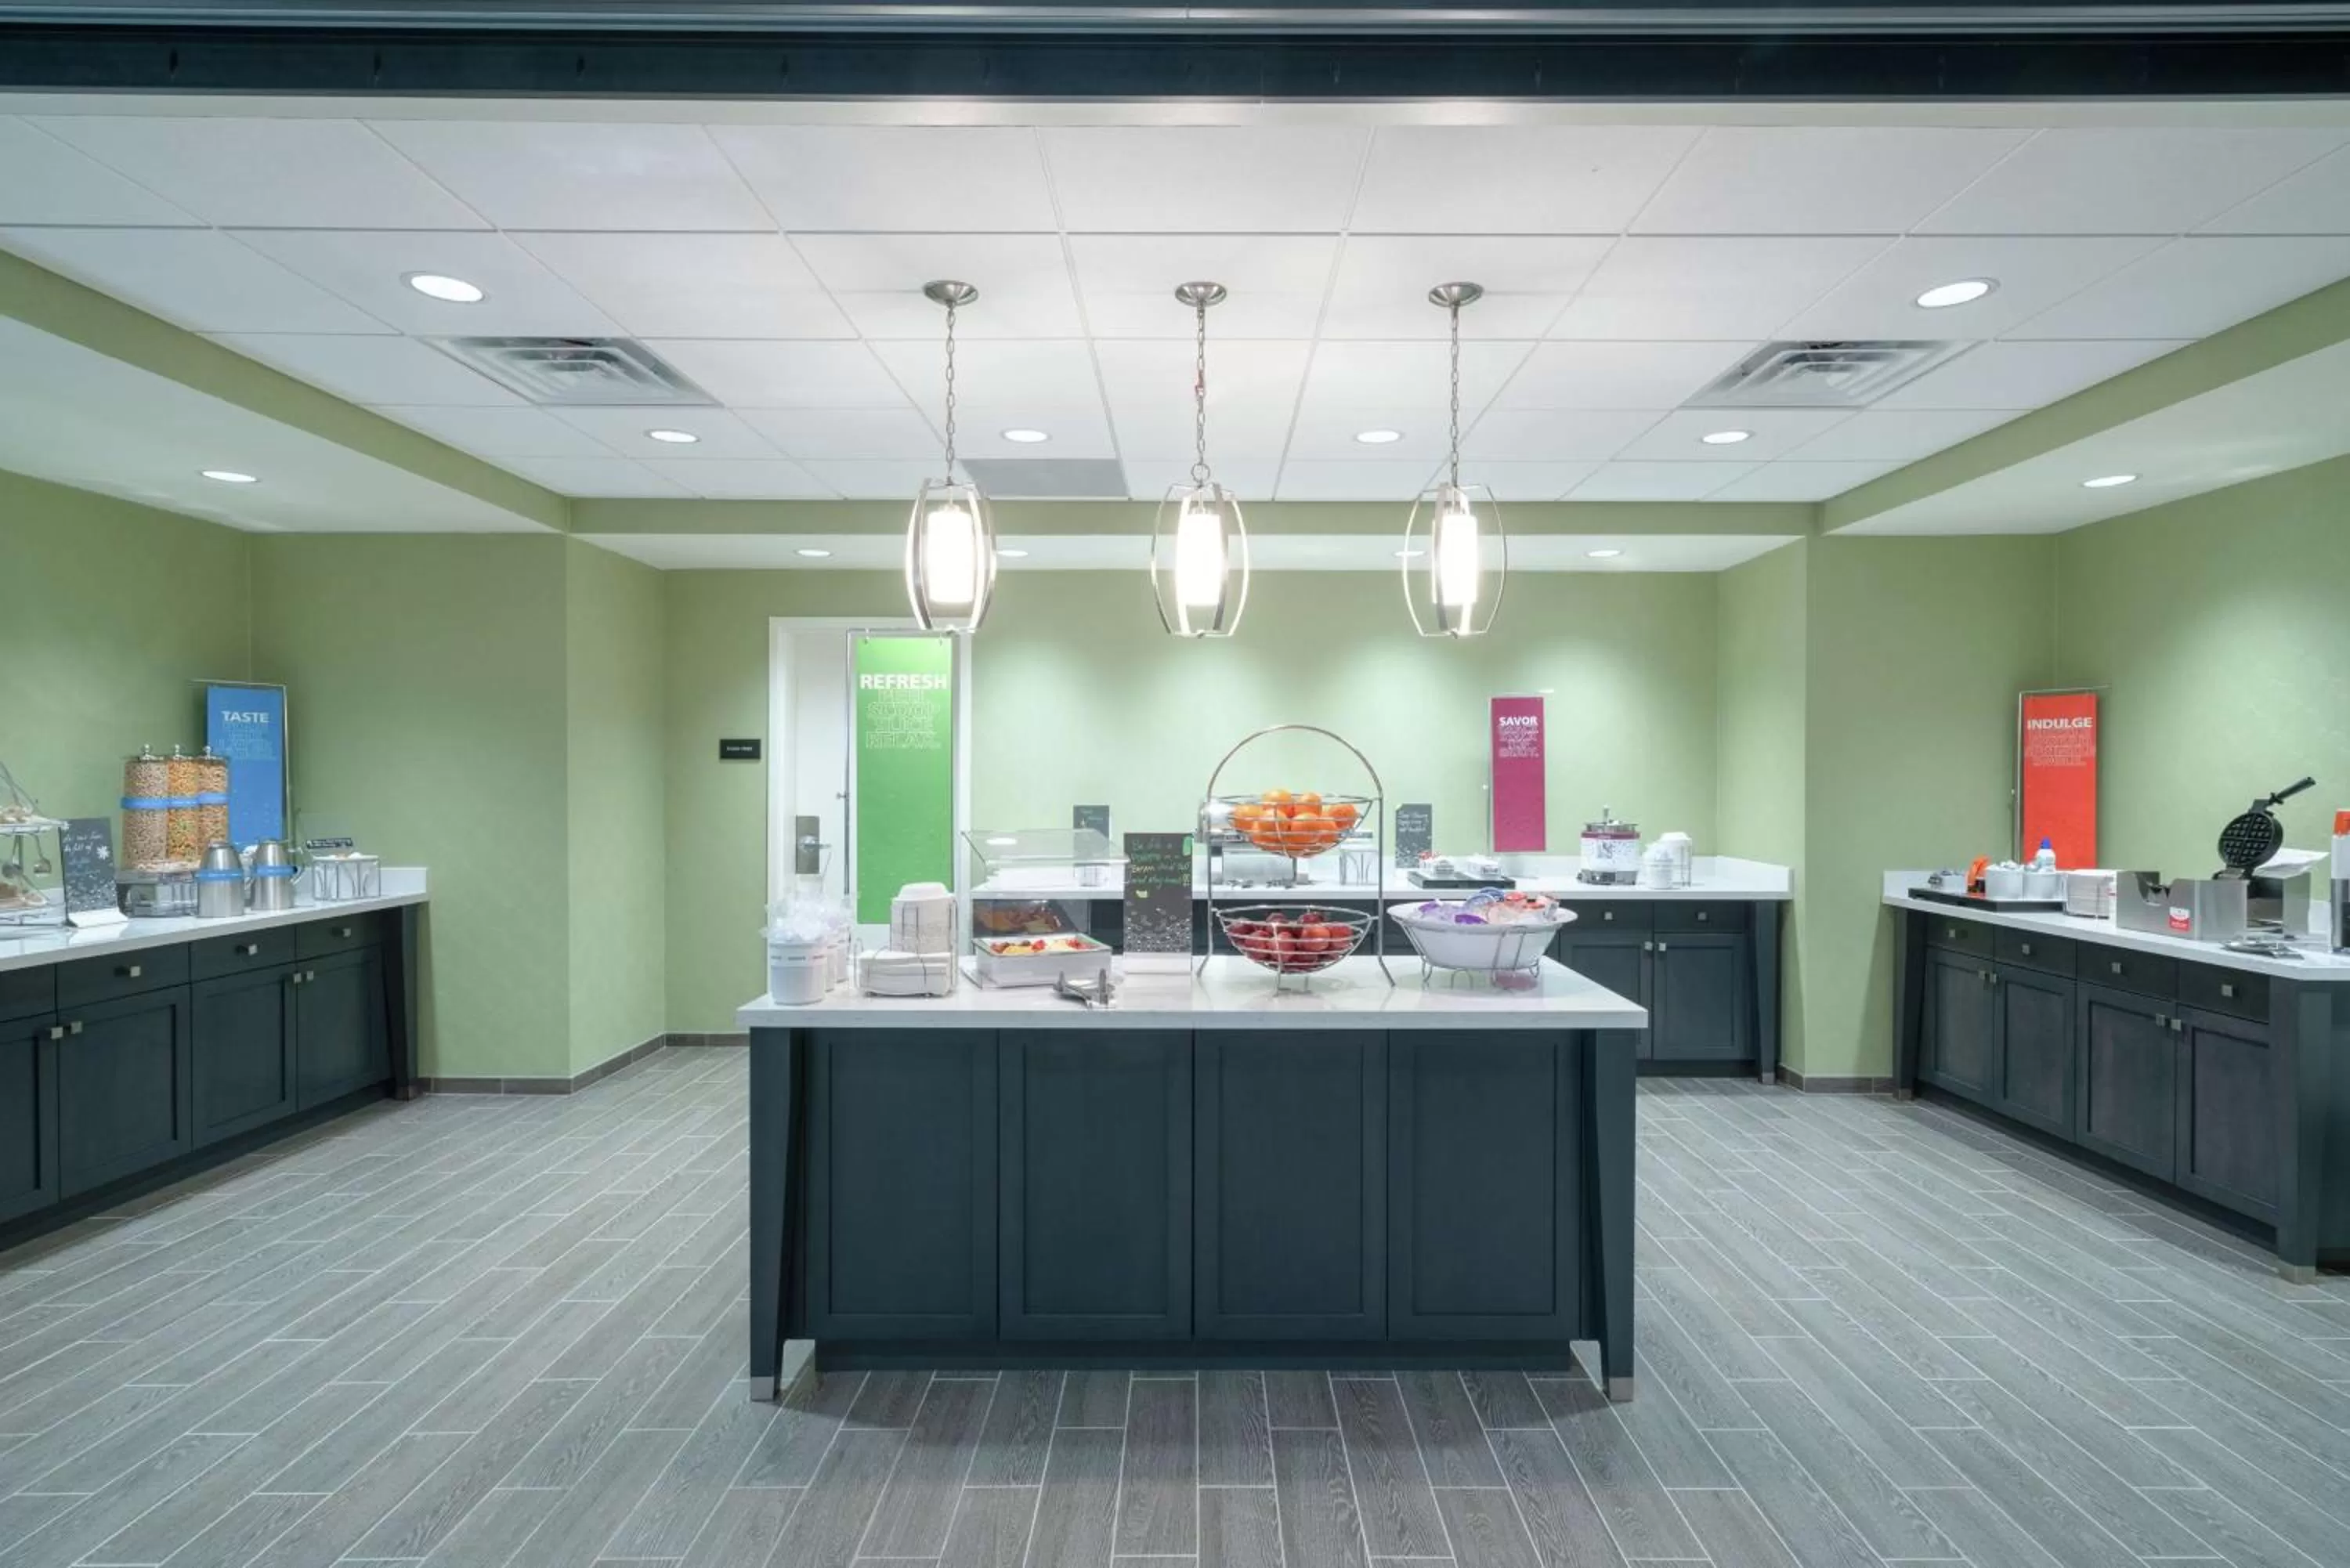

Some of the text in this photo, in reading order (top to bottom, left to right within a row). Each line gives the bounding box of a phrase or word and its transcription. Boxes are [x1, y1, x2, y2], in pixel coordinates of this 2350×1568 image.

[859, 673, 947, 690] REFRESH
[221, 710, 269, 723] TASTE
[1499, 716, 1538, 726] SAVOR
[2027, 717, 2093, 730] INDULGE
